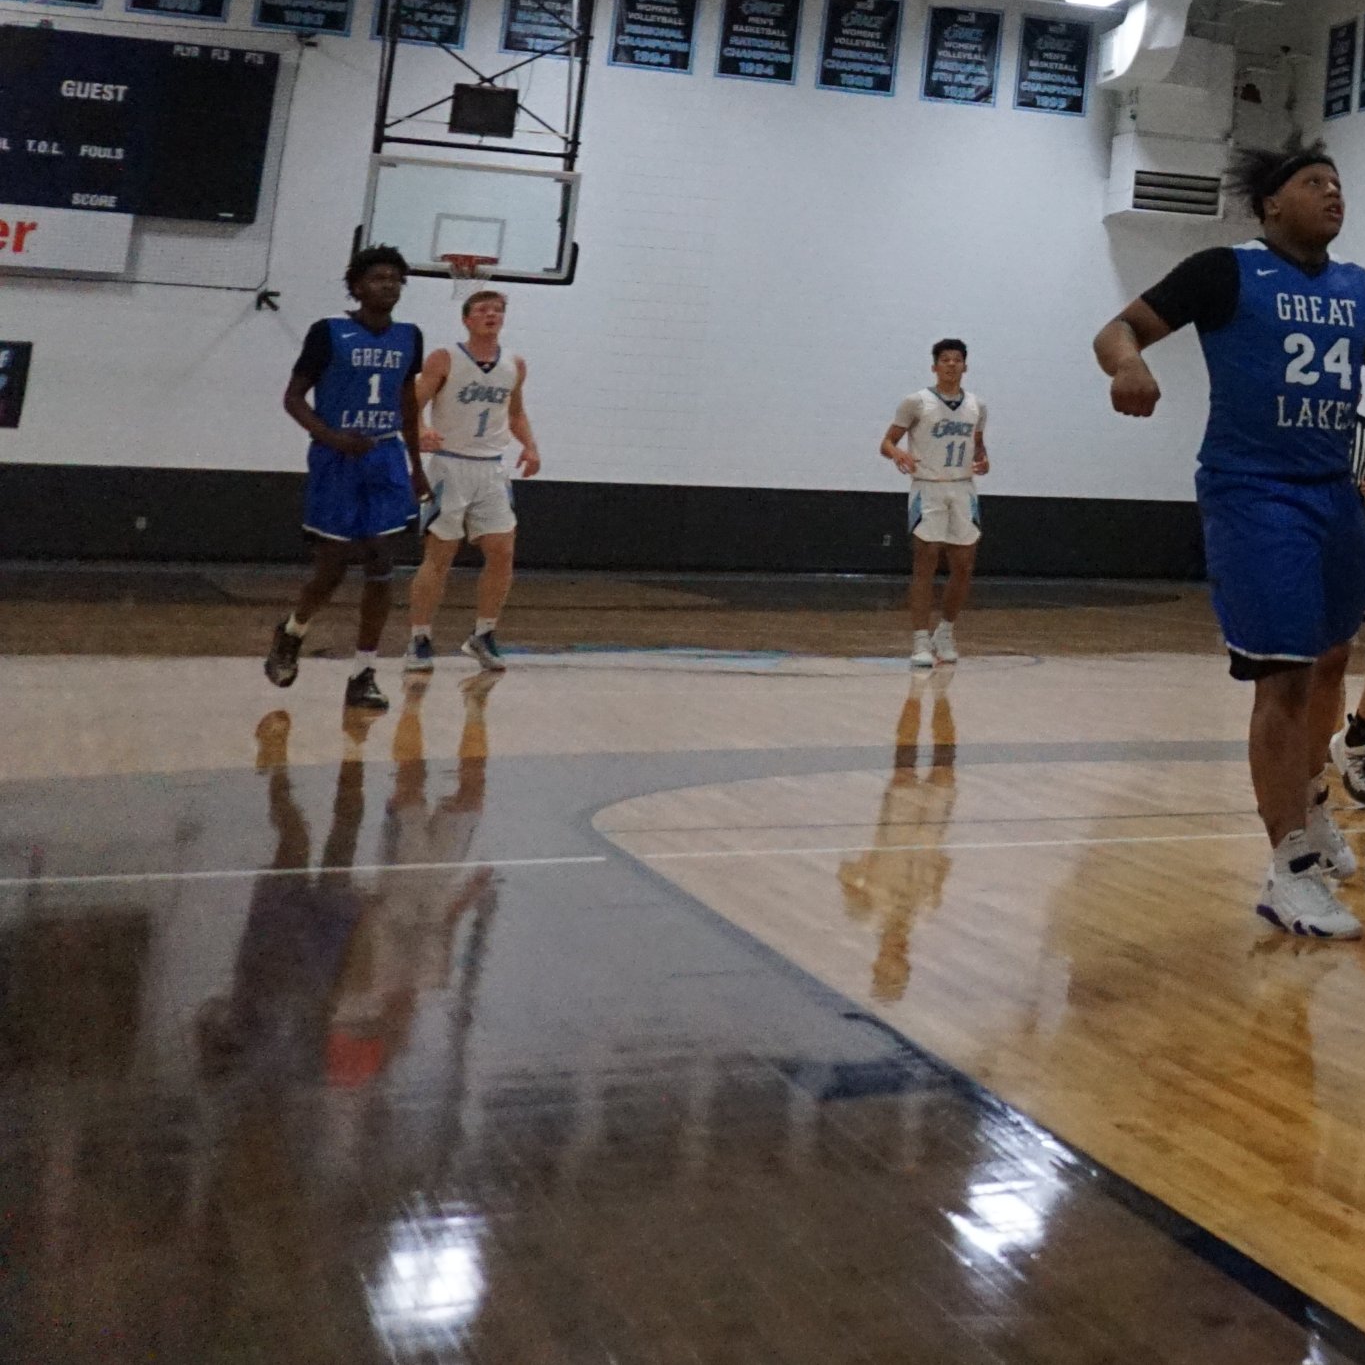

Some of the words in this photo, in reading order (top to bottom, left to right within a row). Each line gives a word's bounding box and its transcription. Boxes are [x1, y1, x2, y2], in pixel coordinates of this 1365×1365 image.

[61, 80, 128, 101] GUEST
[79, 144, 124, 160] FOULS
[71, 192, 117, 208] SCORE
[1277, 292, 1356, 327] GREAT
[352, 348, 402, 369] GREAT
[1283, 333, 1352, 390] 24
[367, 373, 381, 404] 1
[457, 381, 509, 404] GRACE
[474, 408, 490, 437] 1
[944, 441, 966, 467] 11
